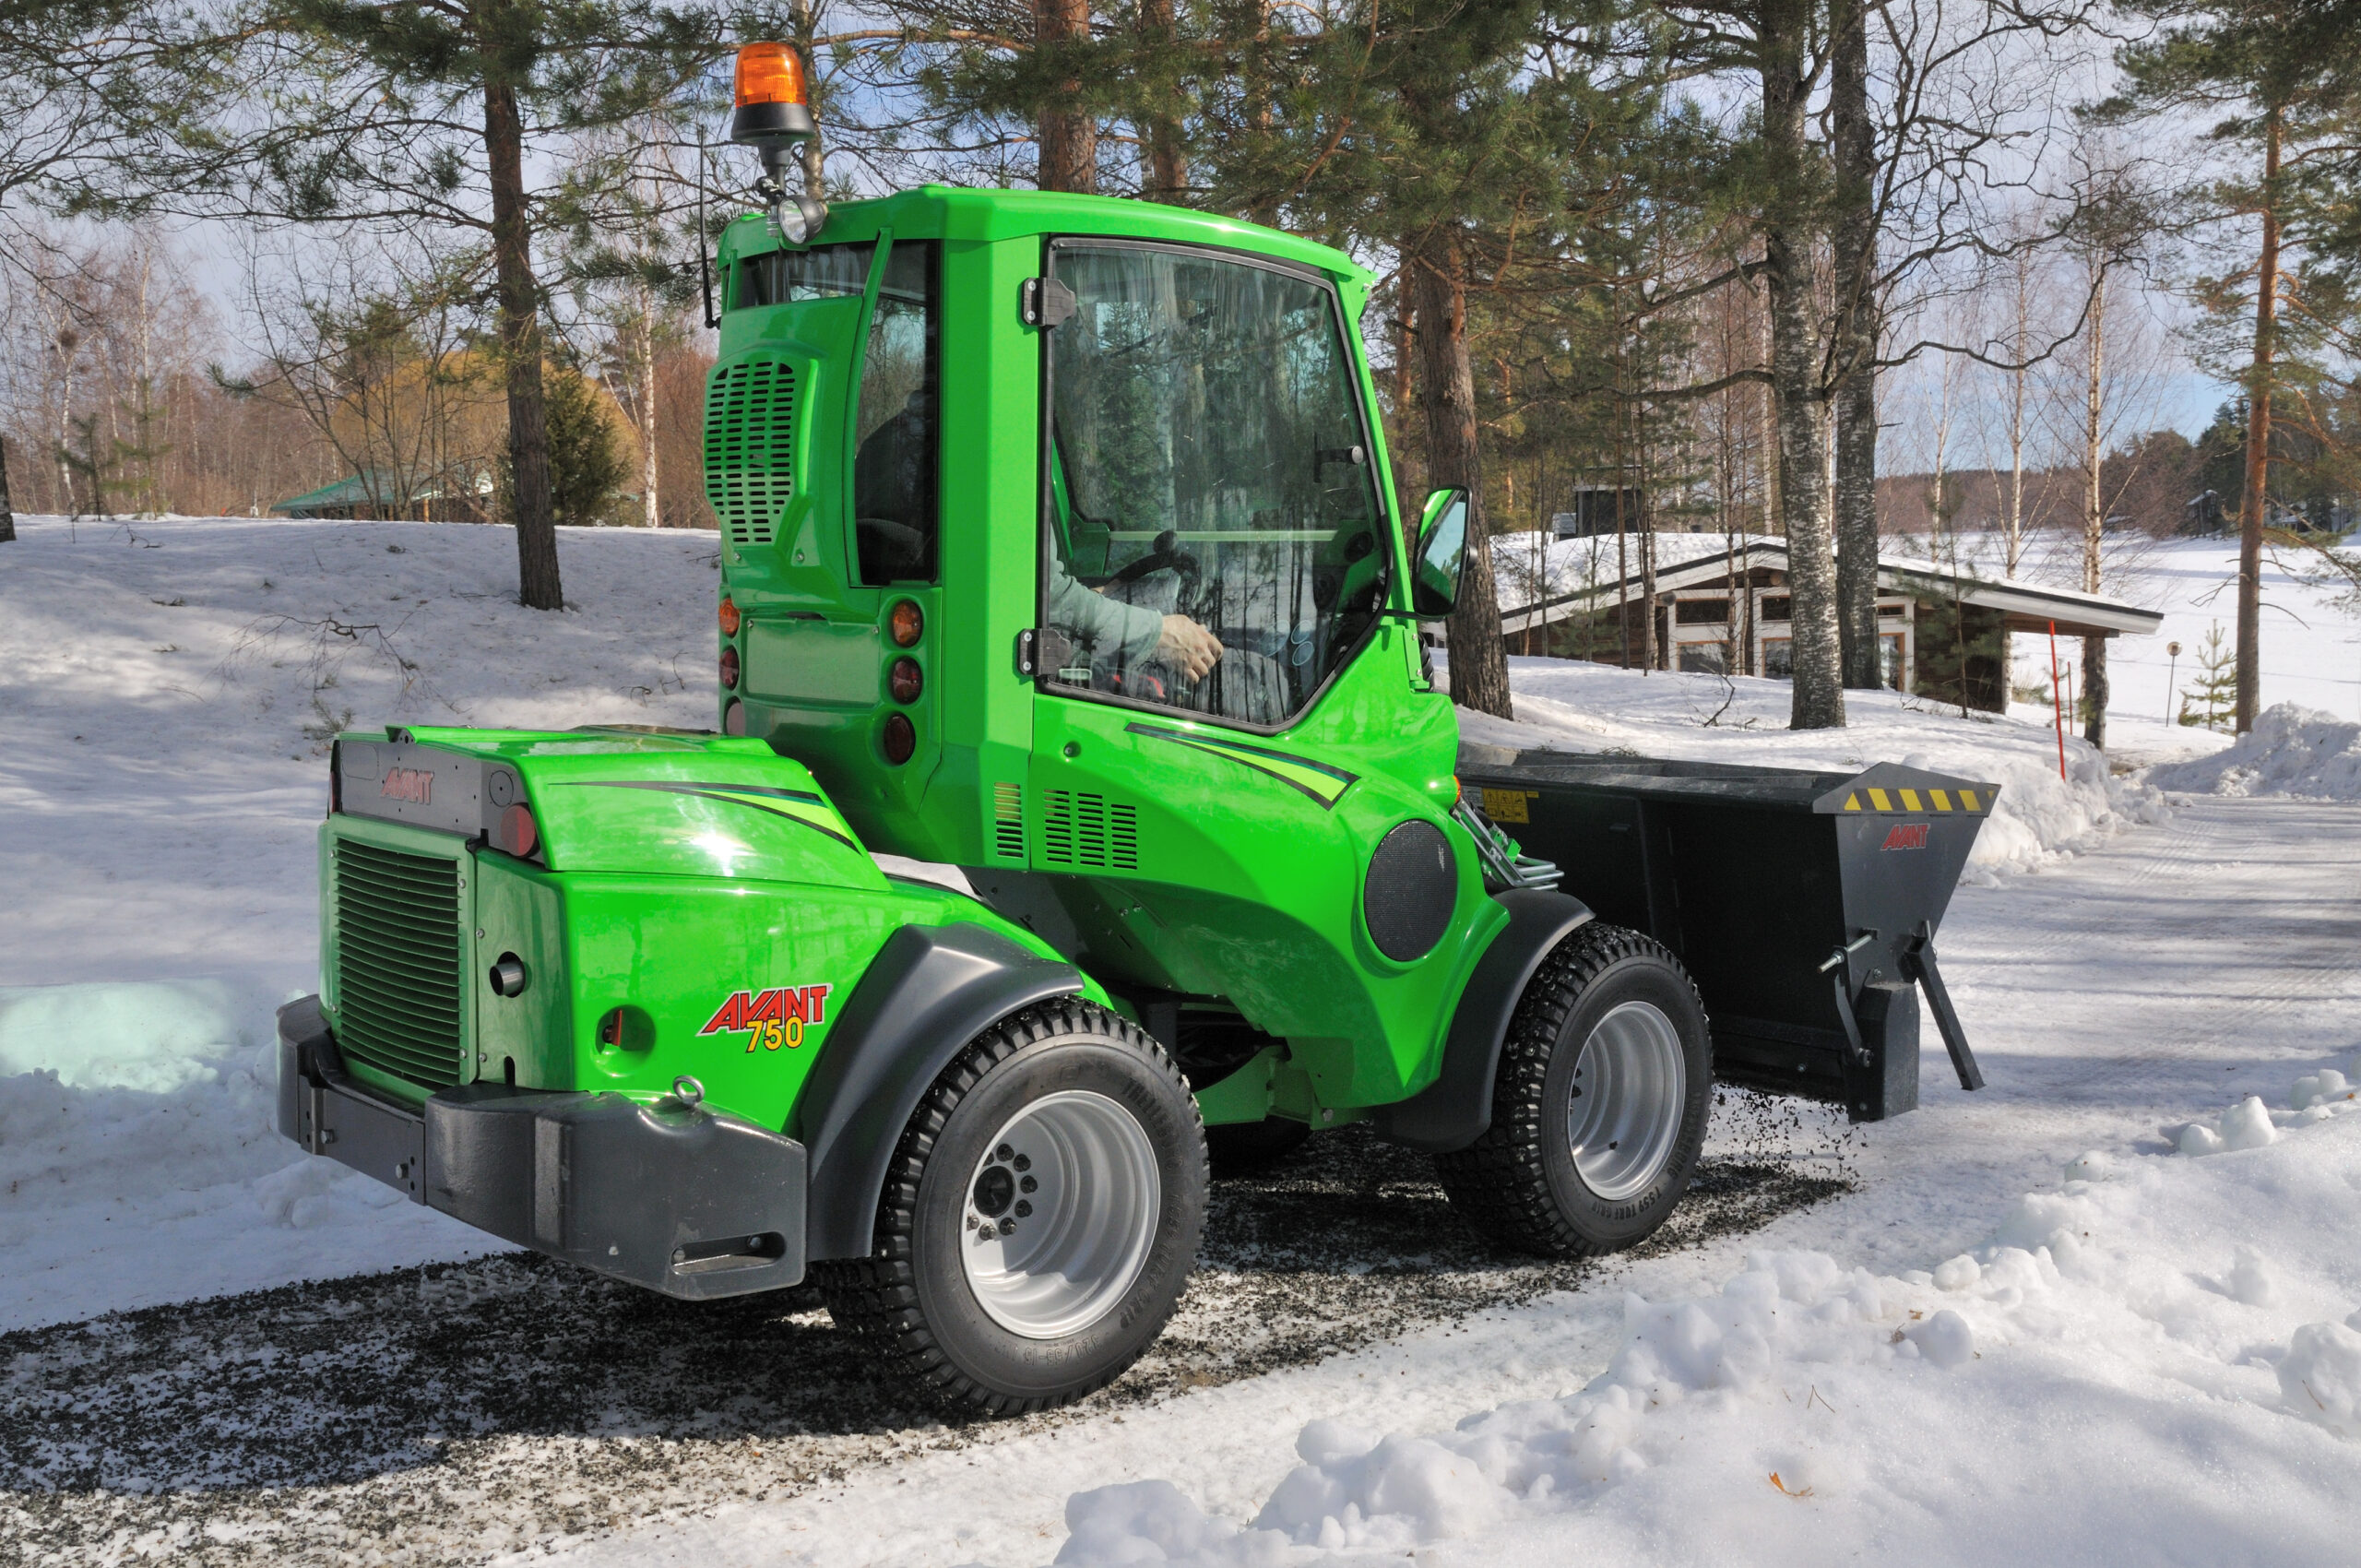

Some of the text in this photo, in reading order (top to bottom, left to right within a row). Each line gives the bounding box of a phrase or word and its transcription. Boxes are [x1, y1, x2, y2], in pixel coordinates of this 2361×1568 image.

[380, 766, 434, 805] AVANT
[1880, 823, 1930, 850] AVANT
[697, 984, 830, 1036] AVANT
[745, 1016, 804, 1053] 750
[1592, 1201, 1614, 1218] GRIP
[1614, 1204, 1638, 1221] TURF
[1120, 1288, 1151, 1329] GRIP
